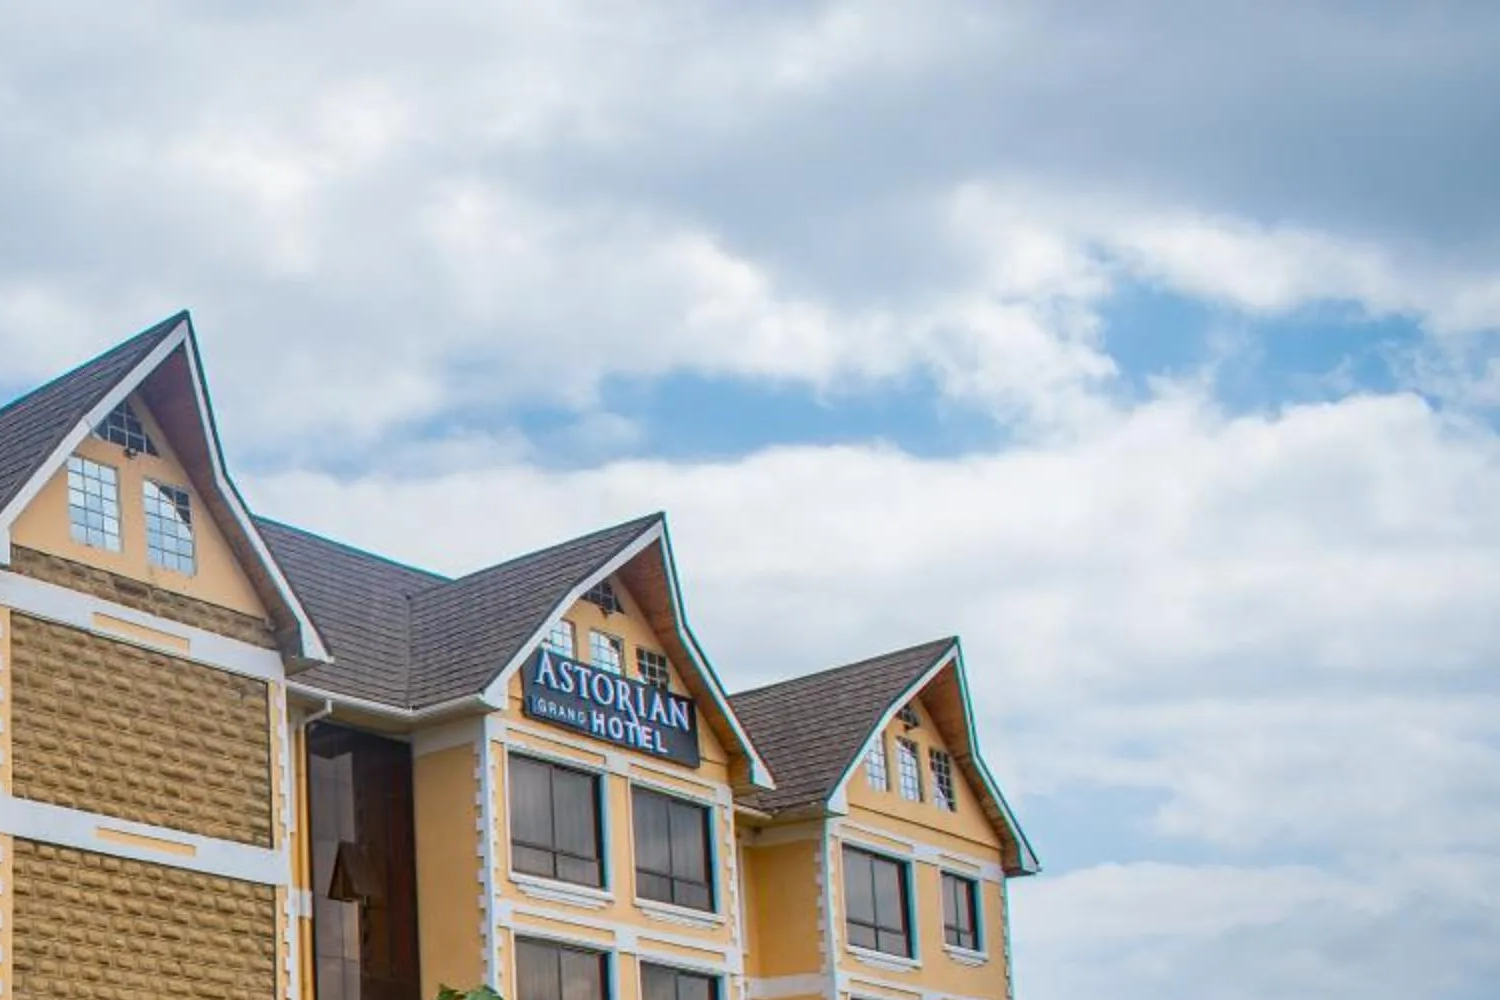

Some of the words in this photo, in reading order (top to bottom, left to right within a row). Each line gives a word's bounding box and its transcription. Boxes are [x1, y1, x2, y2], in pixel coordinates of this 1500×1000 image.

[535, 650, 690, 732] ASTORIAN
[536, 697, 586, 724] GRAND
[590, 710, 668, 753] HOTEL
